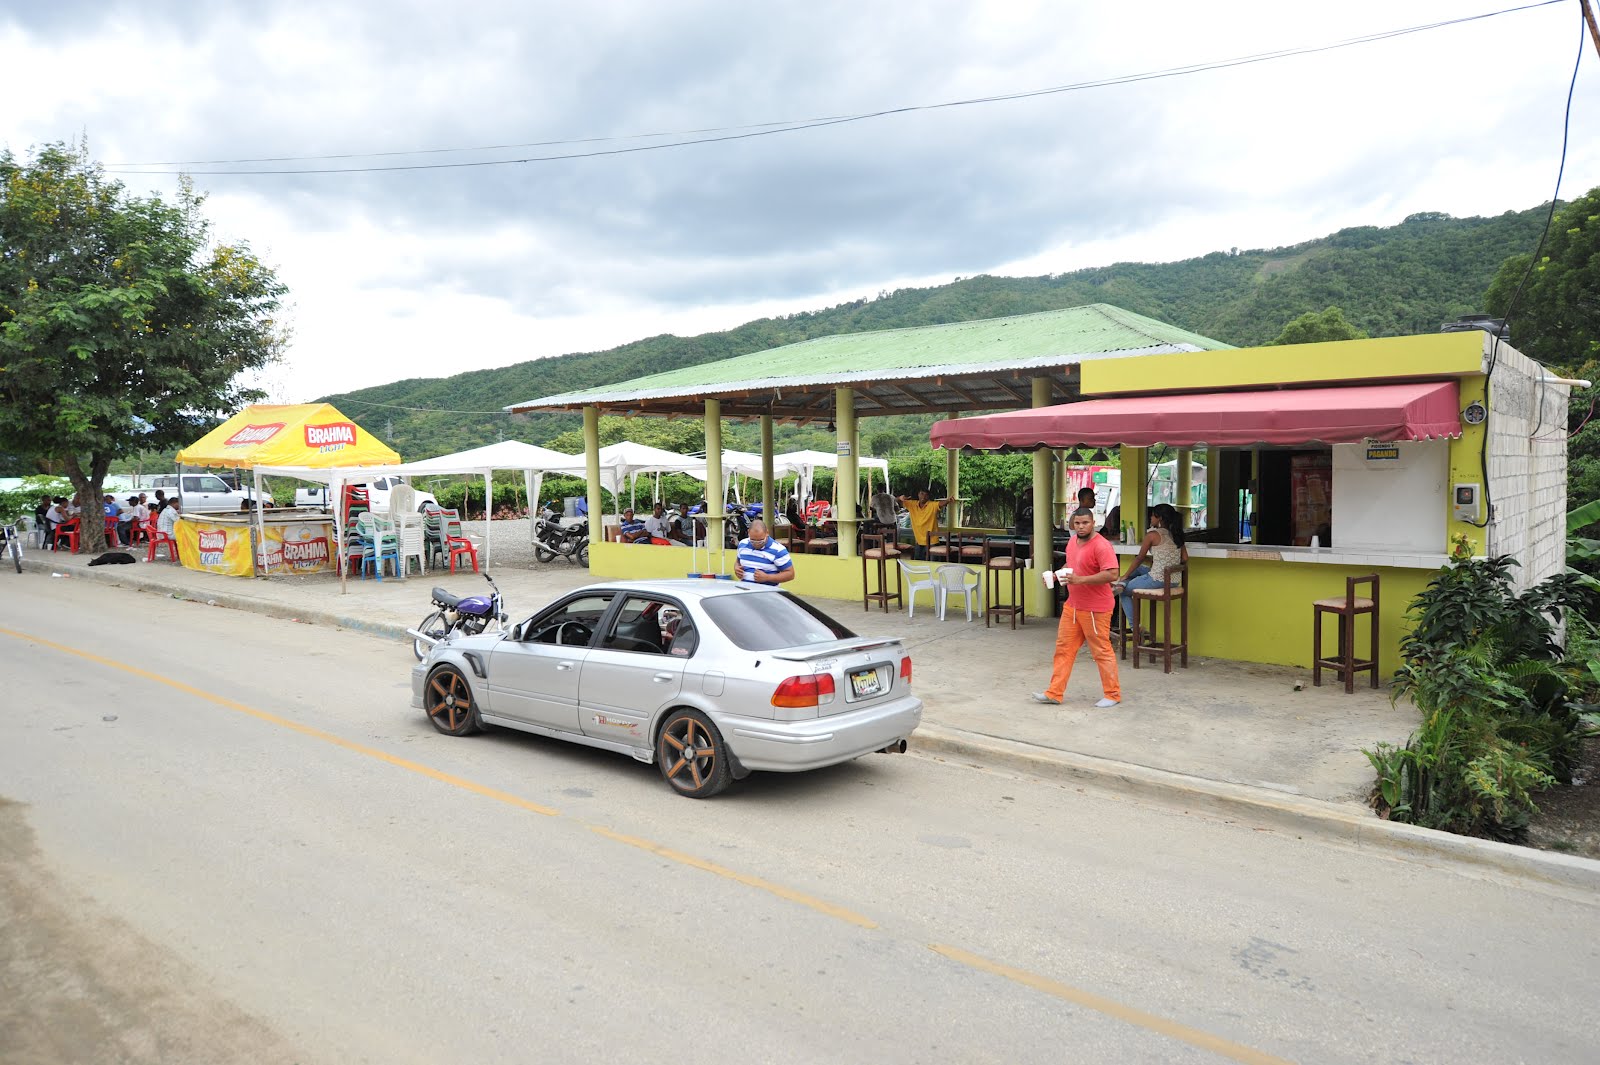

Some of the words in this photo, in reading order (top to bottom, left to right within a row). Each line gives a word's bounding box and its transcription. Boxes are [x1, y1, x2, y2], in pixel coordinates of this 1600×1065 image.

[308, 426, 354, 444] BRAHMA
[320, 442, 347, 454] LIGHT
[1368, 450, 1397, 458] PAGANDO
[199, 532, 225, 550] BRAHMA
[284, 541, 328, 560] BRAHMA
[199, 552, 224, 565] LIGHT
[292, 558, 322, 569] LIGHT
